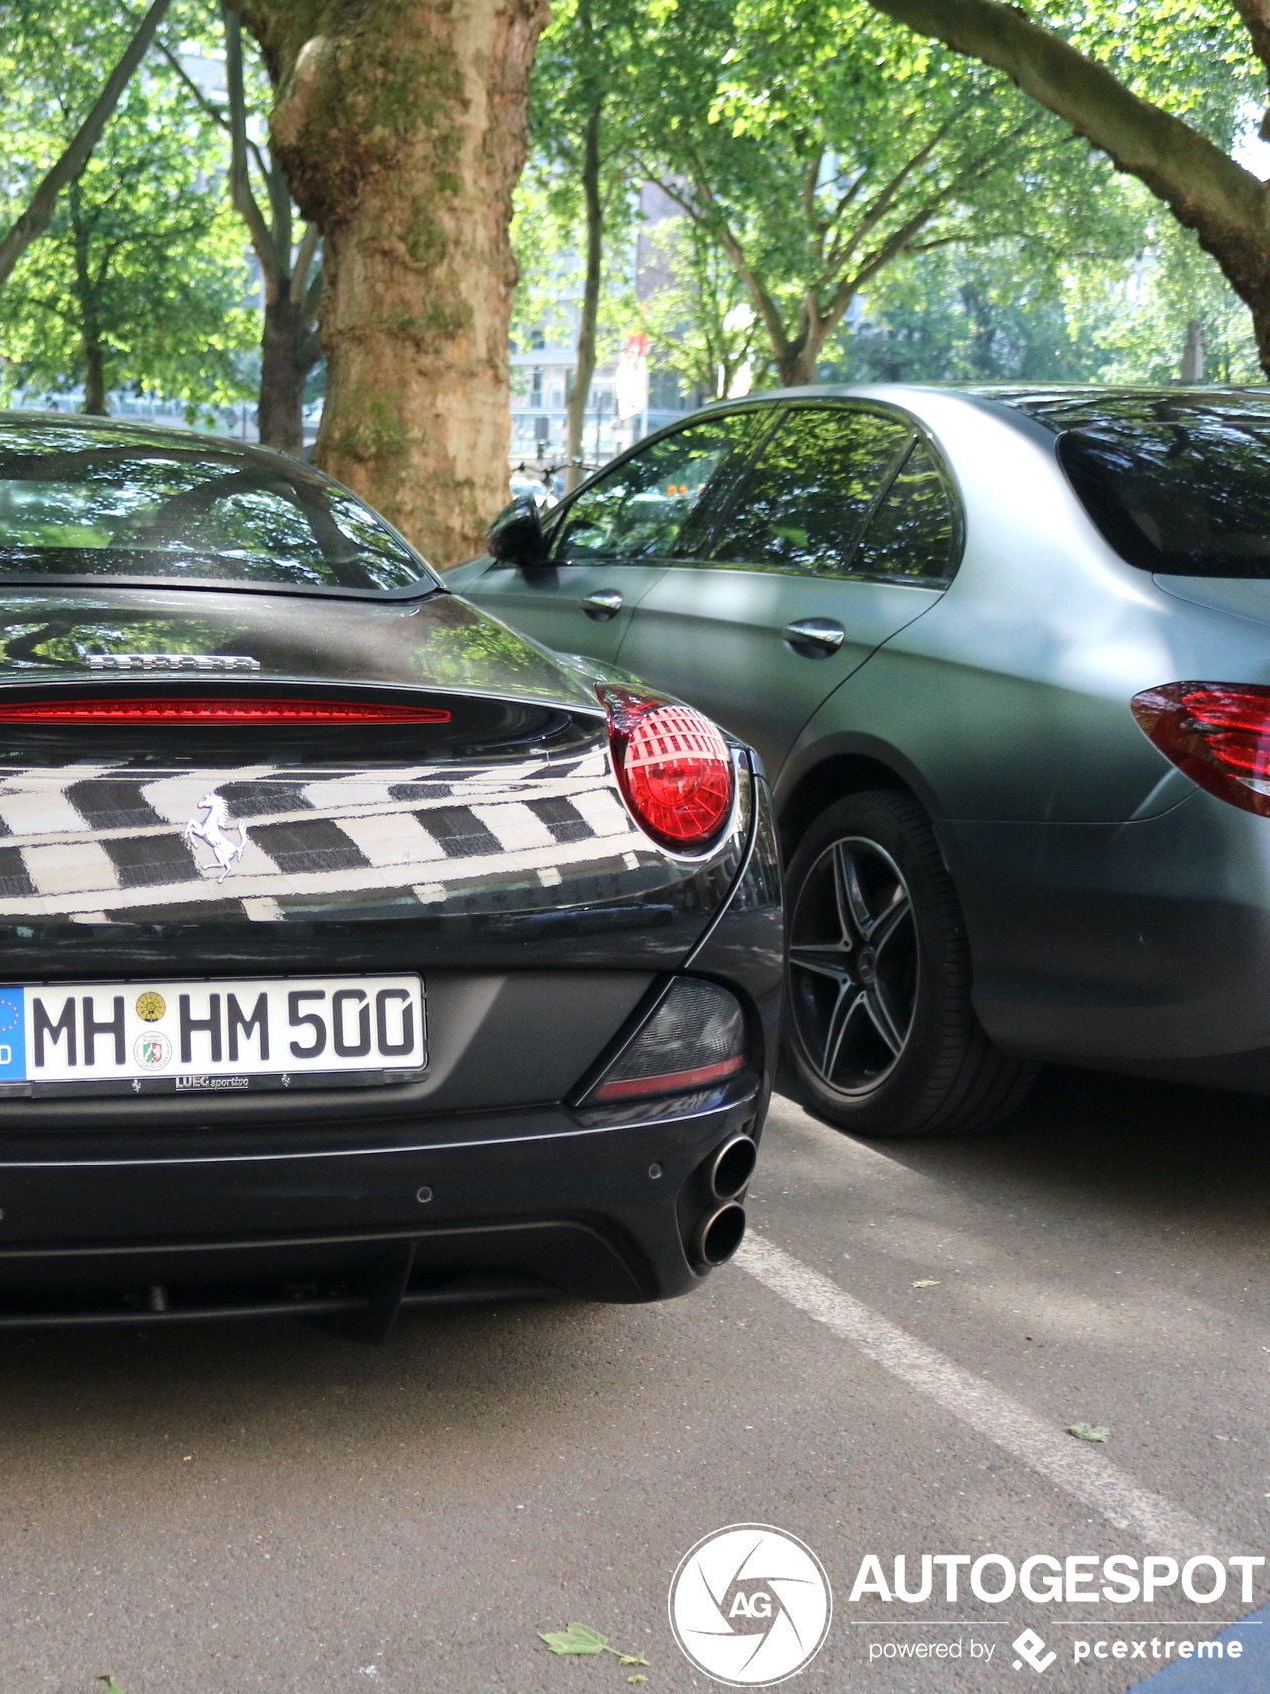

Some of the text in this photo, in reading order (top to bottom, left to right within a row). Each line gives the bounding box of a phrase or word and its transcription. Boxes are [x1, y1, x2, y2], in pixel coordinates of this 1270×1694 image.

[32, 988, 415, 1067] MH HM 500
[175, 1076, 249, 1091] LUEG sportivo
